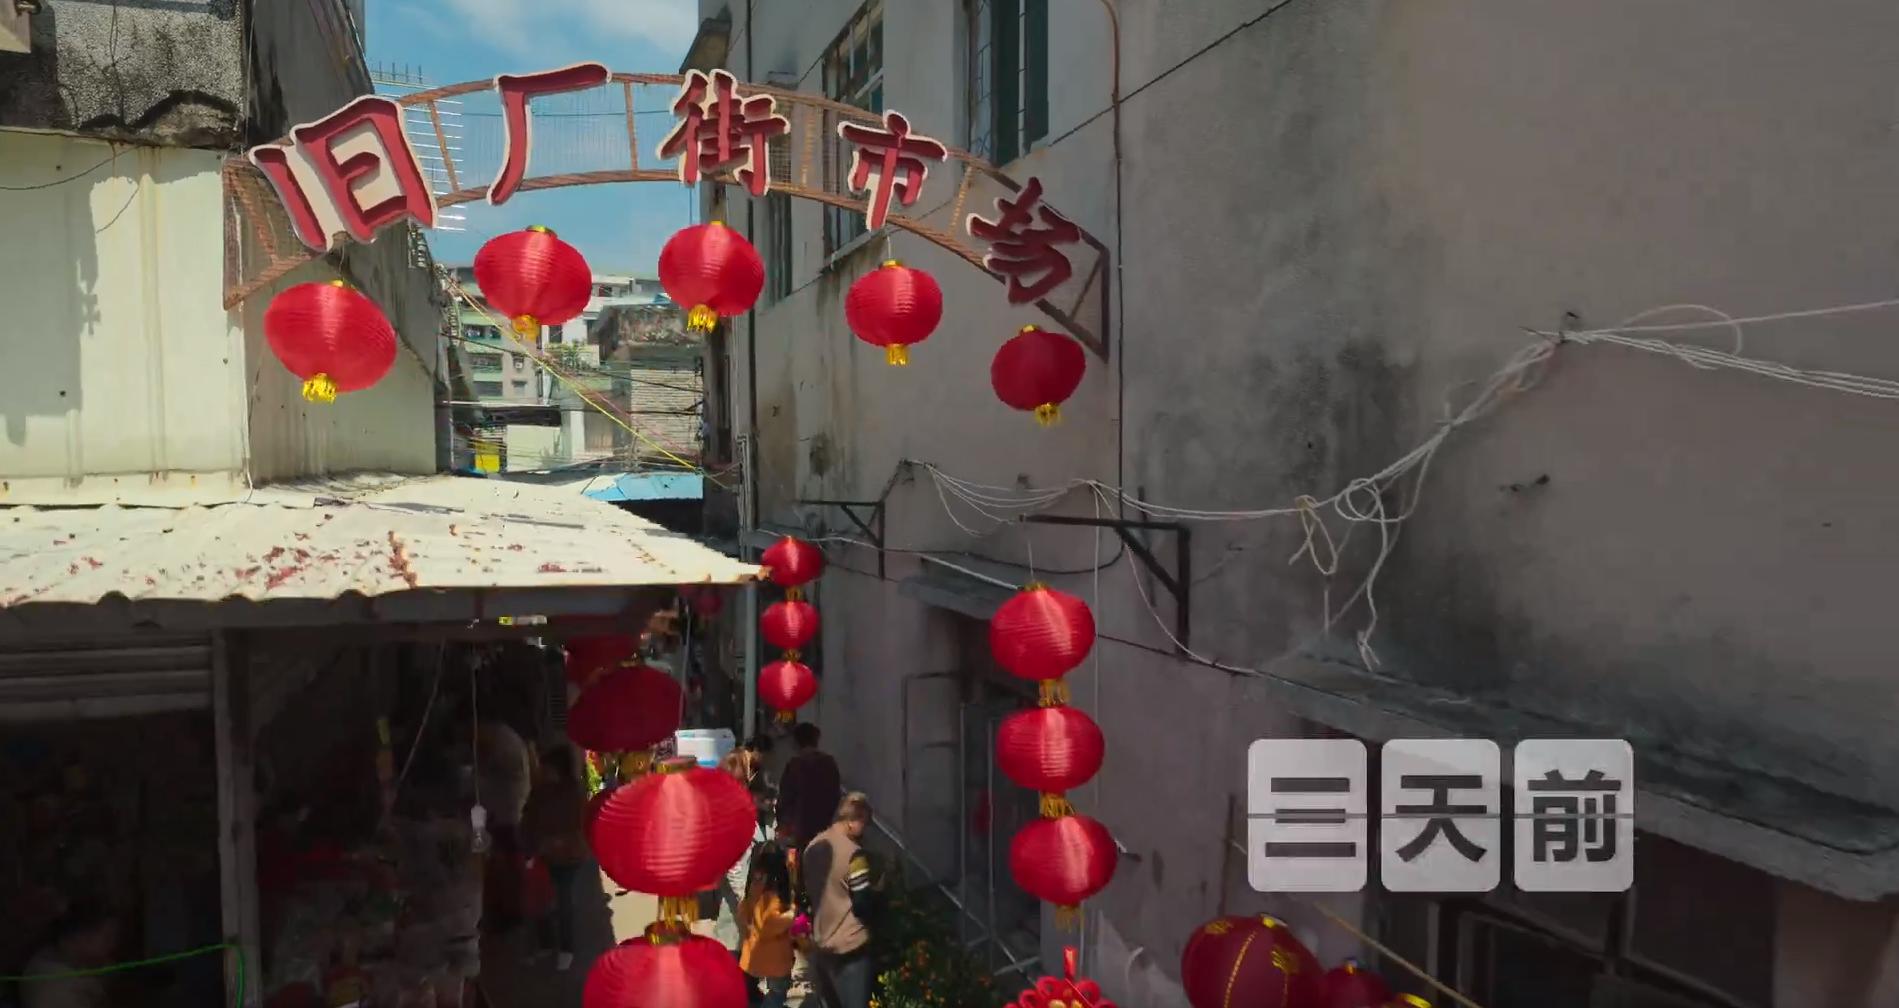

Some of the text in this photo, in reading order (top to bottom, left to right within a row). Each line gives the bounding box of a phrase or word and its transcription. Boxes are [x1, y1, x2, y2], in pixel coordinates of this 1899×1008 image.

[249, 61, 1082, 304] 旧厂街市场
